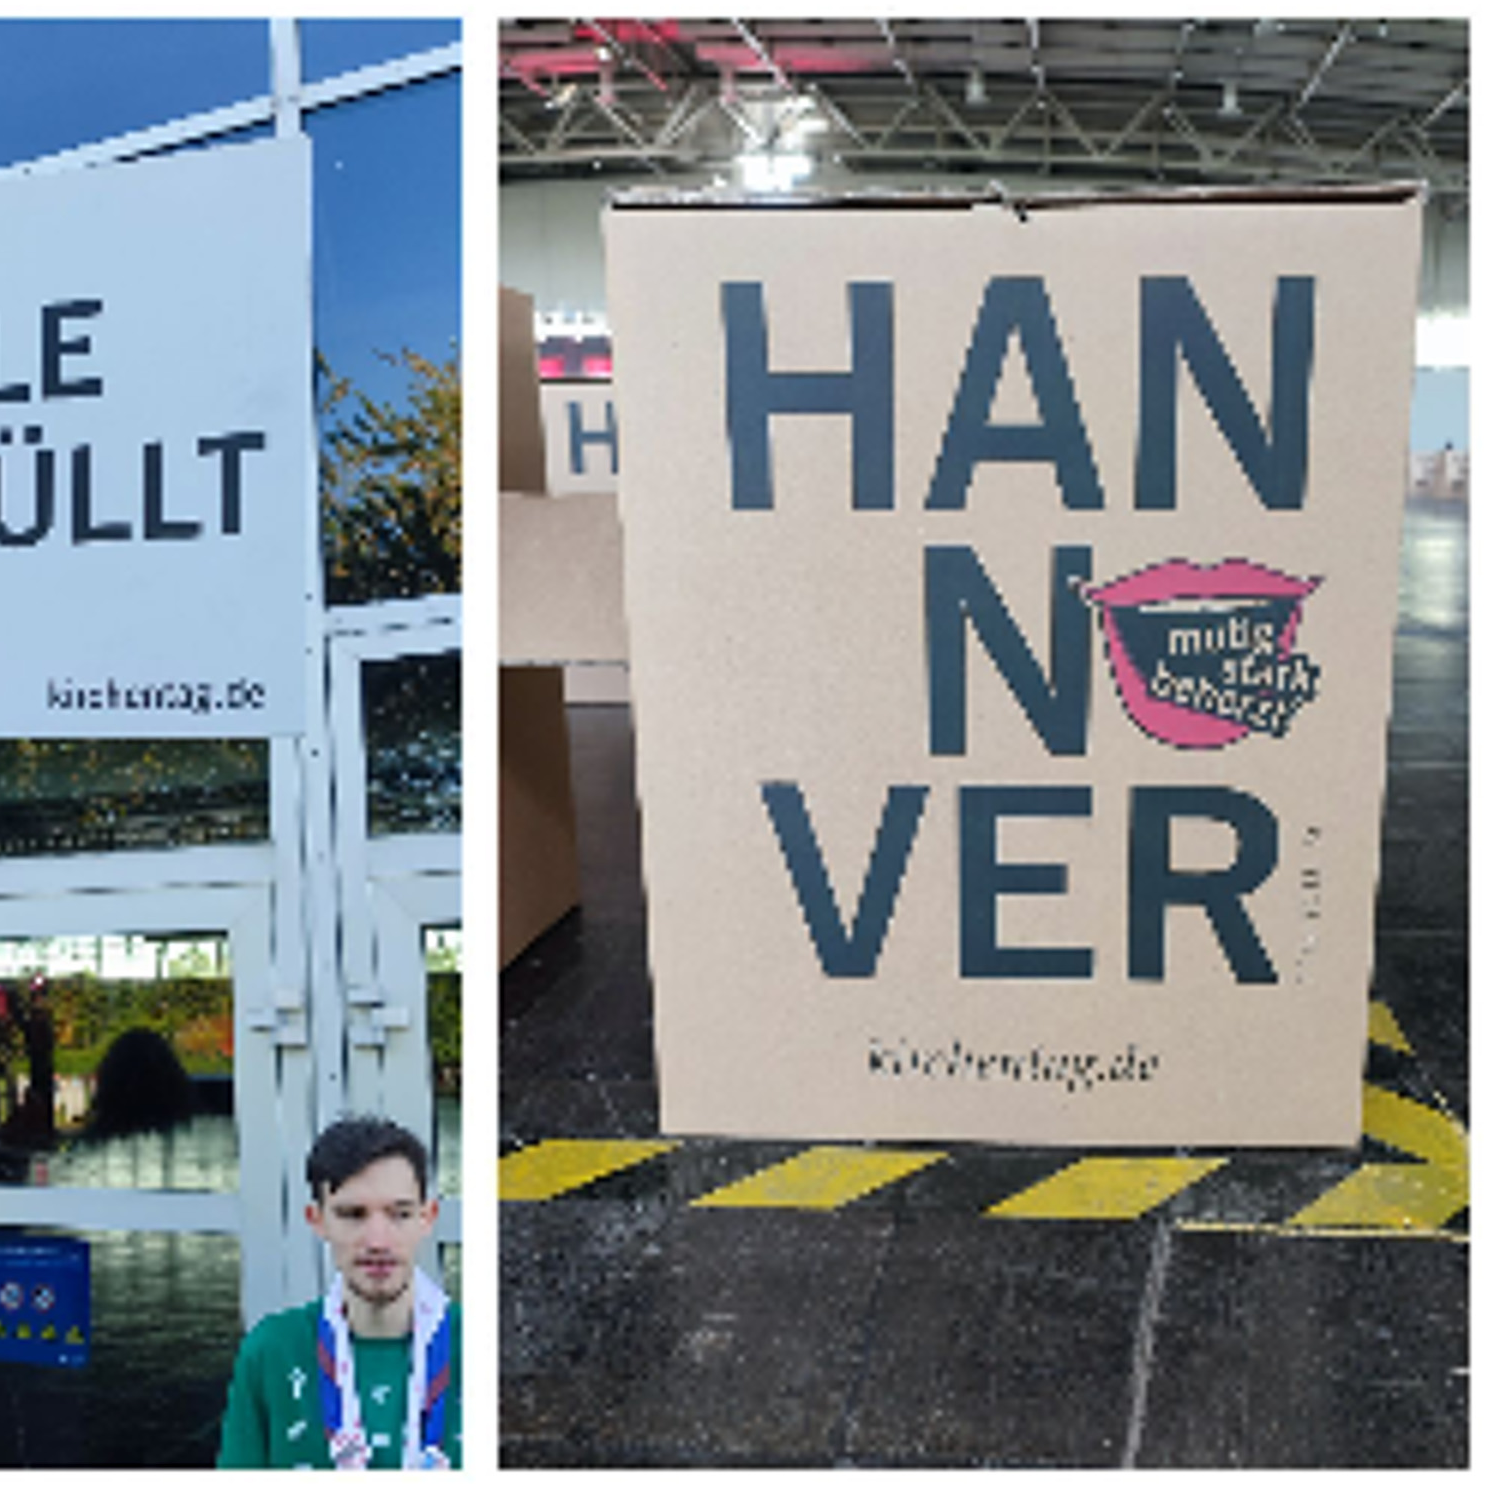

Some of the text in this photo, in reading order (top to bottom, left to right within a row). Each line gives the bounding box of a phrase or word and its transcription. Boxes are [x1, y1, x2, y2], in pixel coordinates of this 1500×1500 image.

[719, 273, 1317, 512] HAN
[1168, 616, 1275, 656] mutig
[47, 677, 266, 716] kirchentag.de
[1221, 654, 1311, 693] stark
[758, 780, 1280, 985] VER
[868, 1037, 1161, 1095] kirchentag.de
